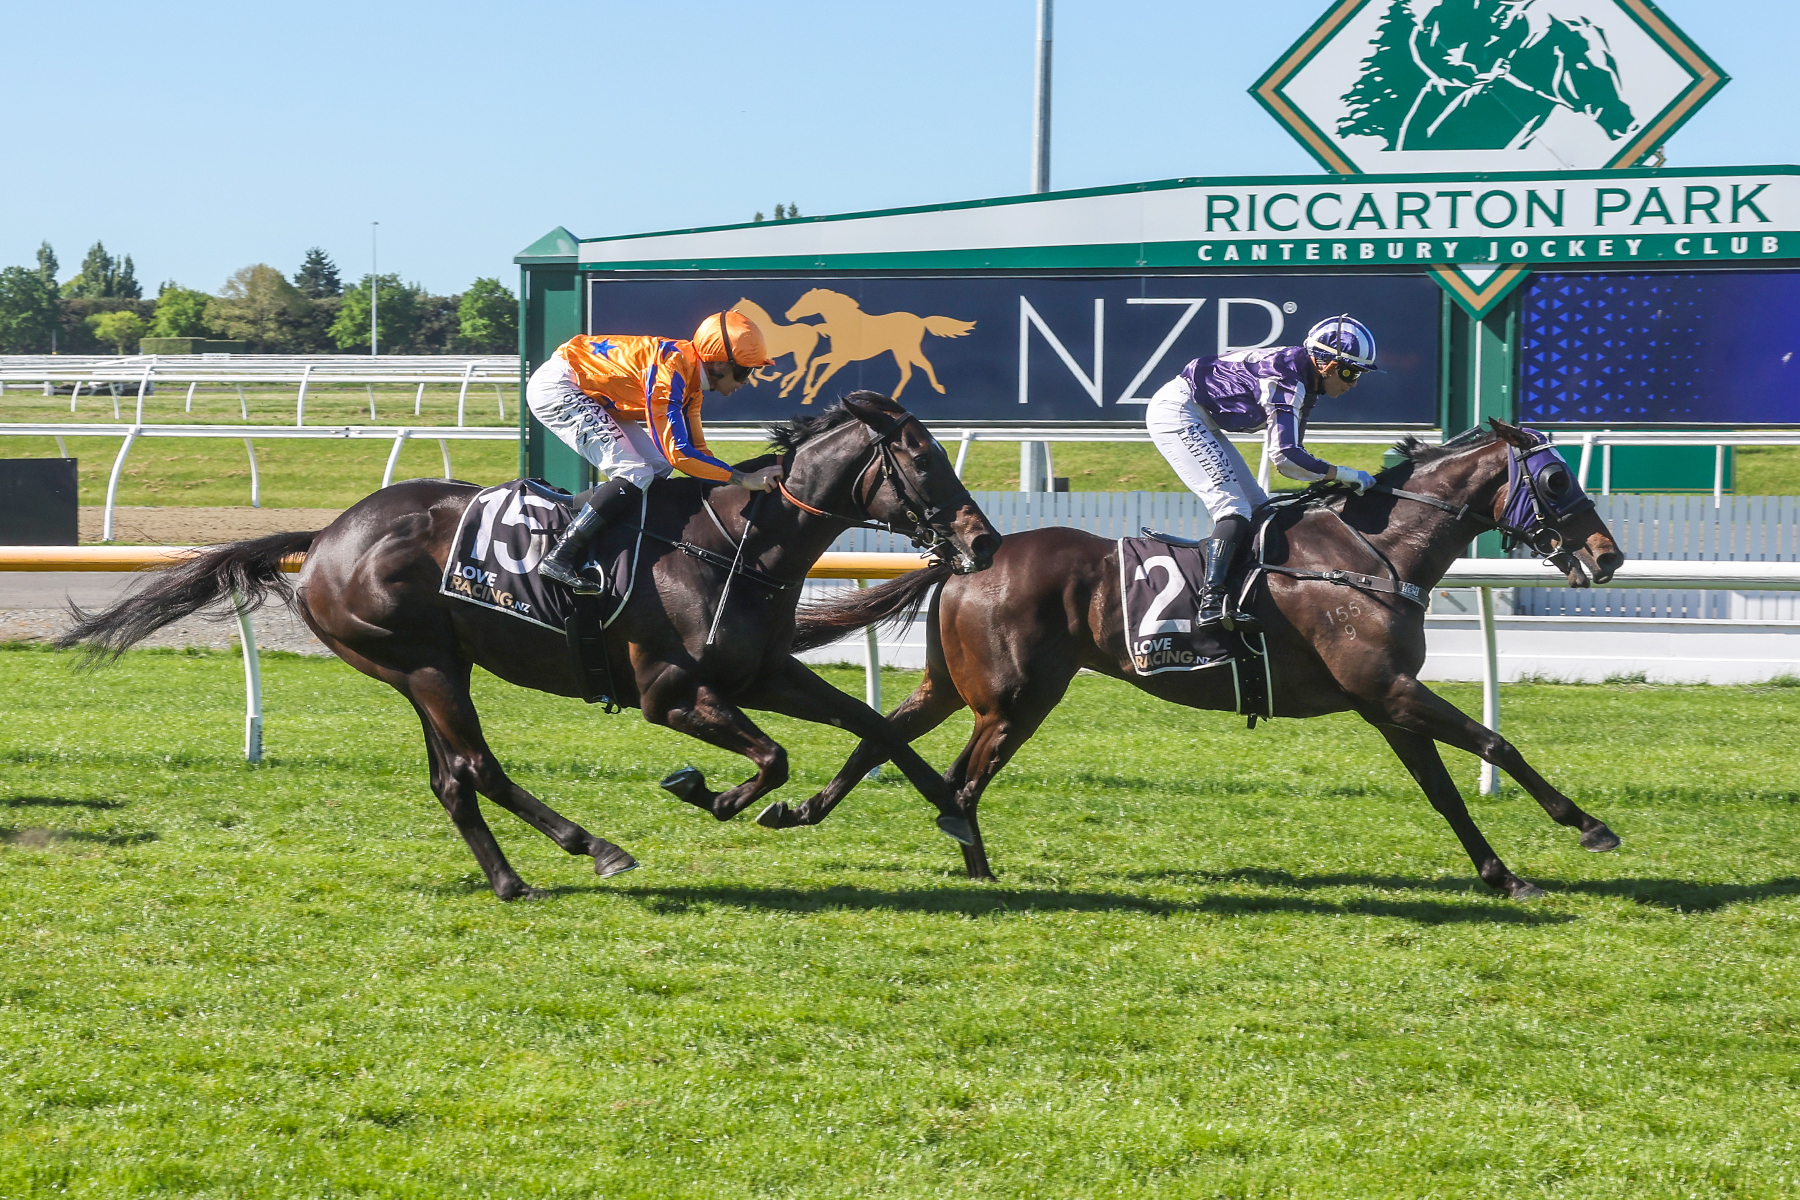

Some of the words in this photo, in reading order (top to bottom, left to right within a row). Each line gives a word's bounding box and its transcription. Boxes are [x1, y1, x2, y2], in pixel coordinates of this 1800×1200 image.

[1204, 188, 1566, 232] RICCARTON
[1594, 183, 1772, 226] PARK
[1198, 242, 1459, 262] CANTERBURY
[1487, 239, 1643, 261] JOCKEY
[1674, 236, 1779, 255] CLUB
[1193, 422, 1207, 439] AL
[1177, 430, 1202, 458] LEAH
[1198, 458, 1223, 487] HEMI
[1187, 425, 1231, 483] EQUIWORLD
[470, 488, 556, 575] 15
[453, 561, 498, 588] LOVE
[451, 575, 531, 613] RACING.NZ
[1134, 555, 1191, 637] 2
[1325, 601, 1361, 625] 155
[1344, 624, 1357, 640] 9
[1133, 637, 1172, 656] LOVE
[1135, 650, 1211, 669] RACING.NZ
